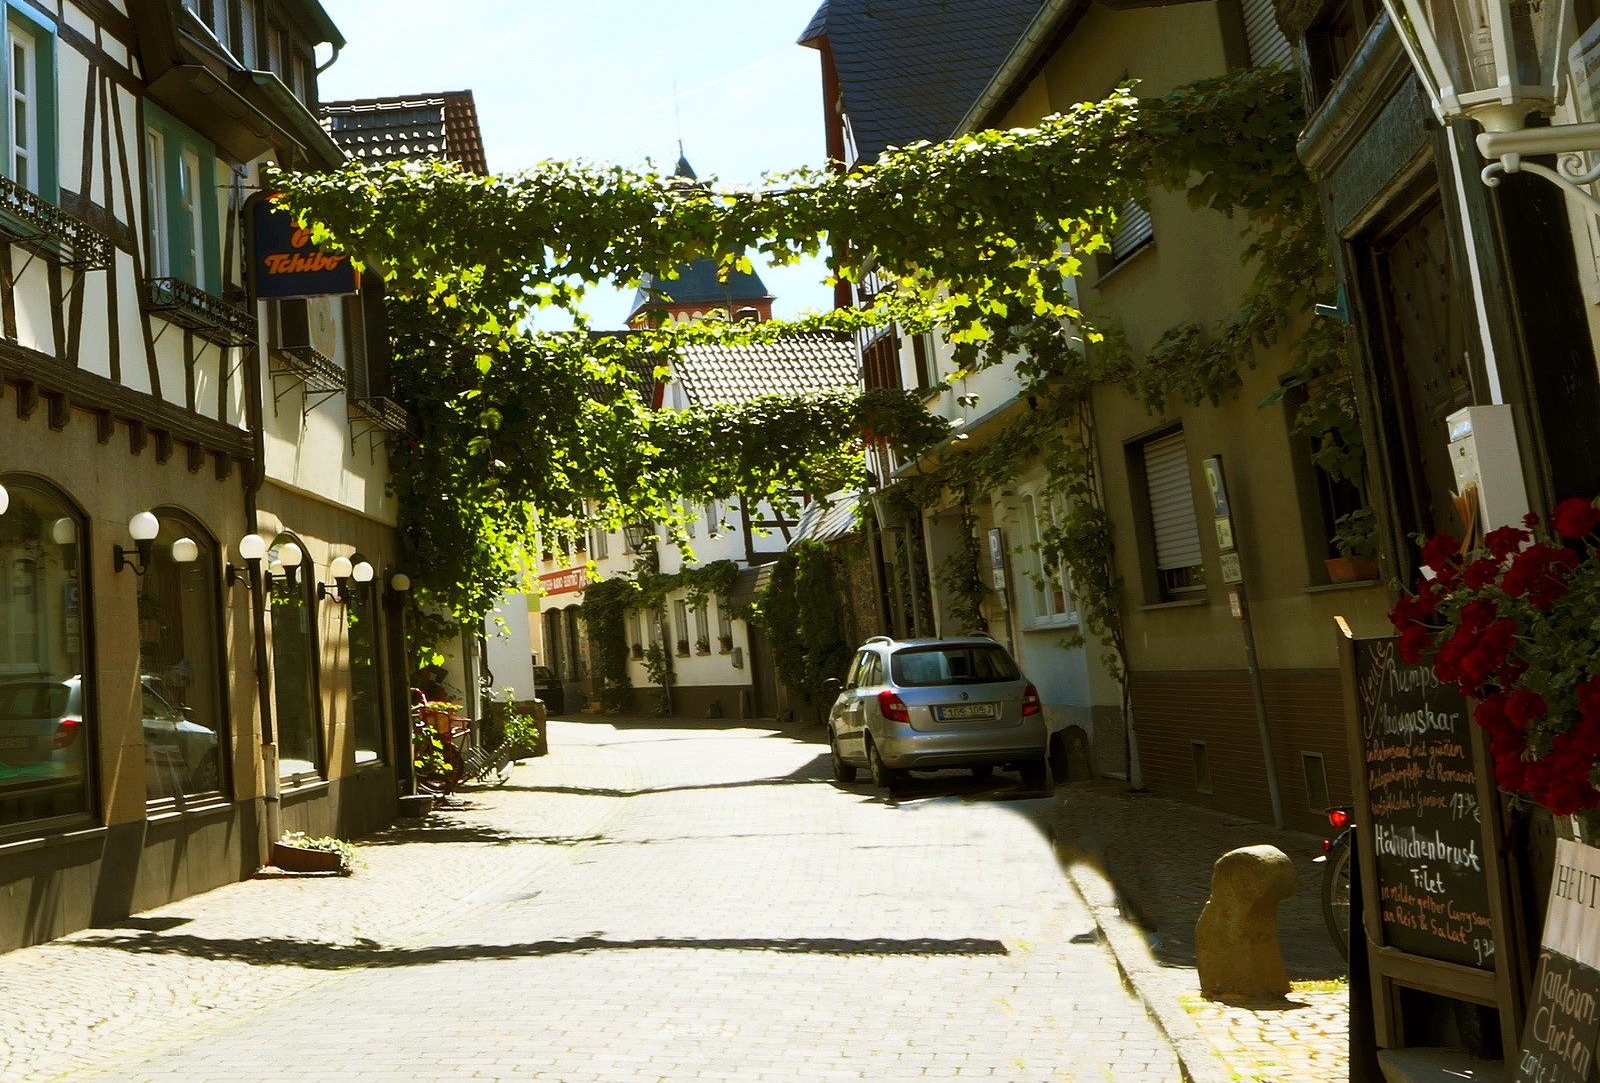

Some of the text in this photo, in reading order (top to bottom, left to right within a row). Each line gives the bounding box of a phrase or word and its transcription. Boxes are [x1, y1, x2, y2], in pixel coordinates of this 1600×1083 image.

[263, 251, 348, 275] Tchibo
[1386, 658, 1463, 699] Rumps
[1410, 865, 1446, 893] Filet
[1430, 919, 1468, 946] Salat
[1533, 1003, 1592, 1082] Chicken
